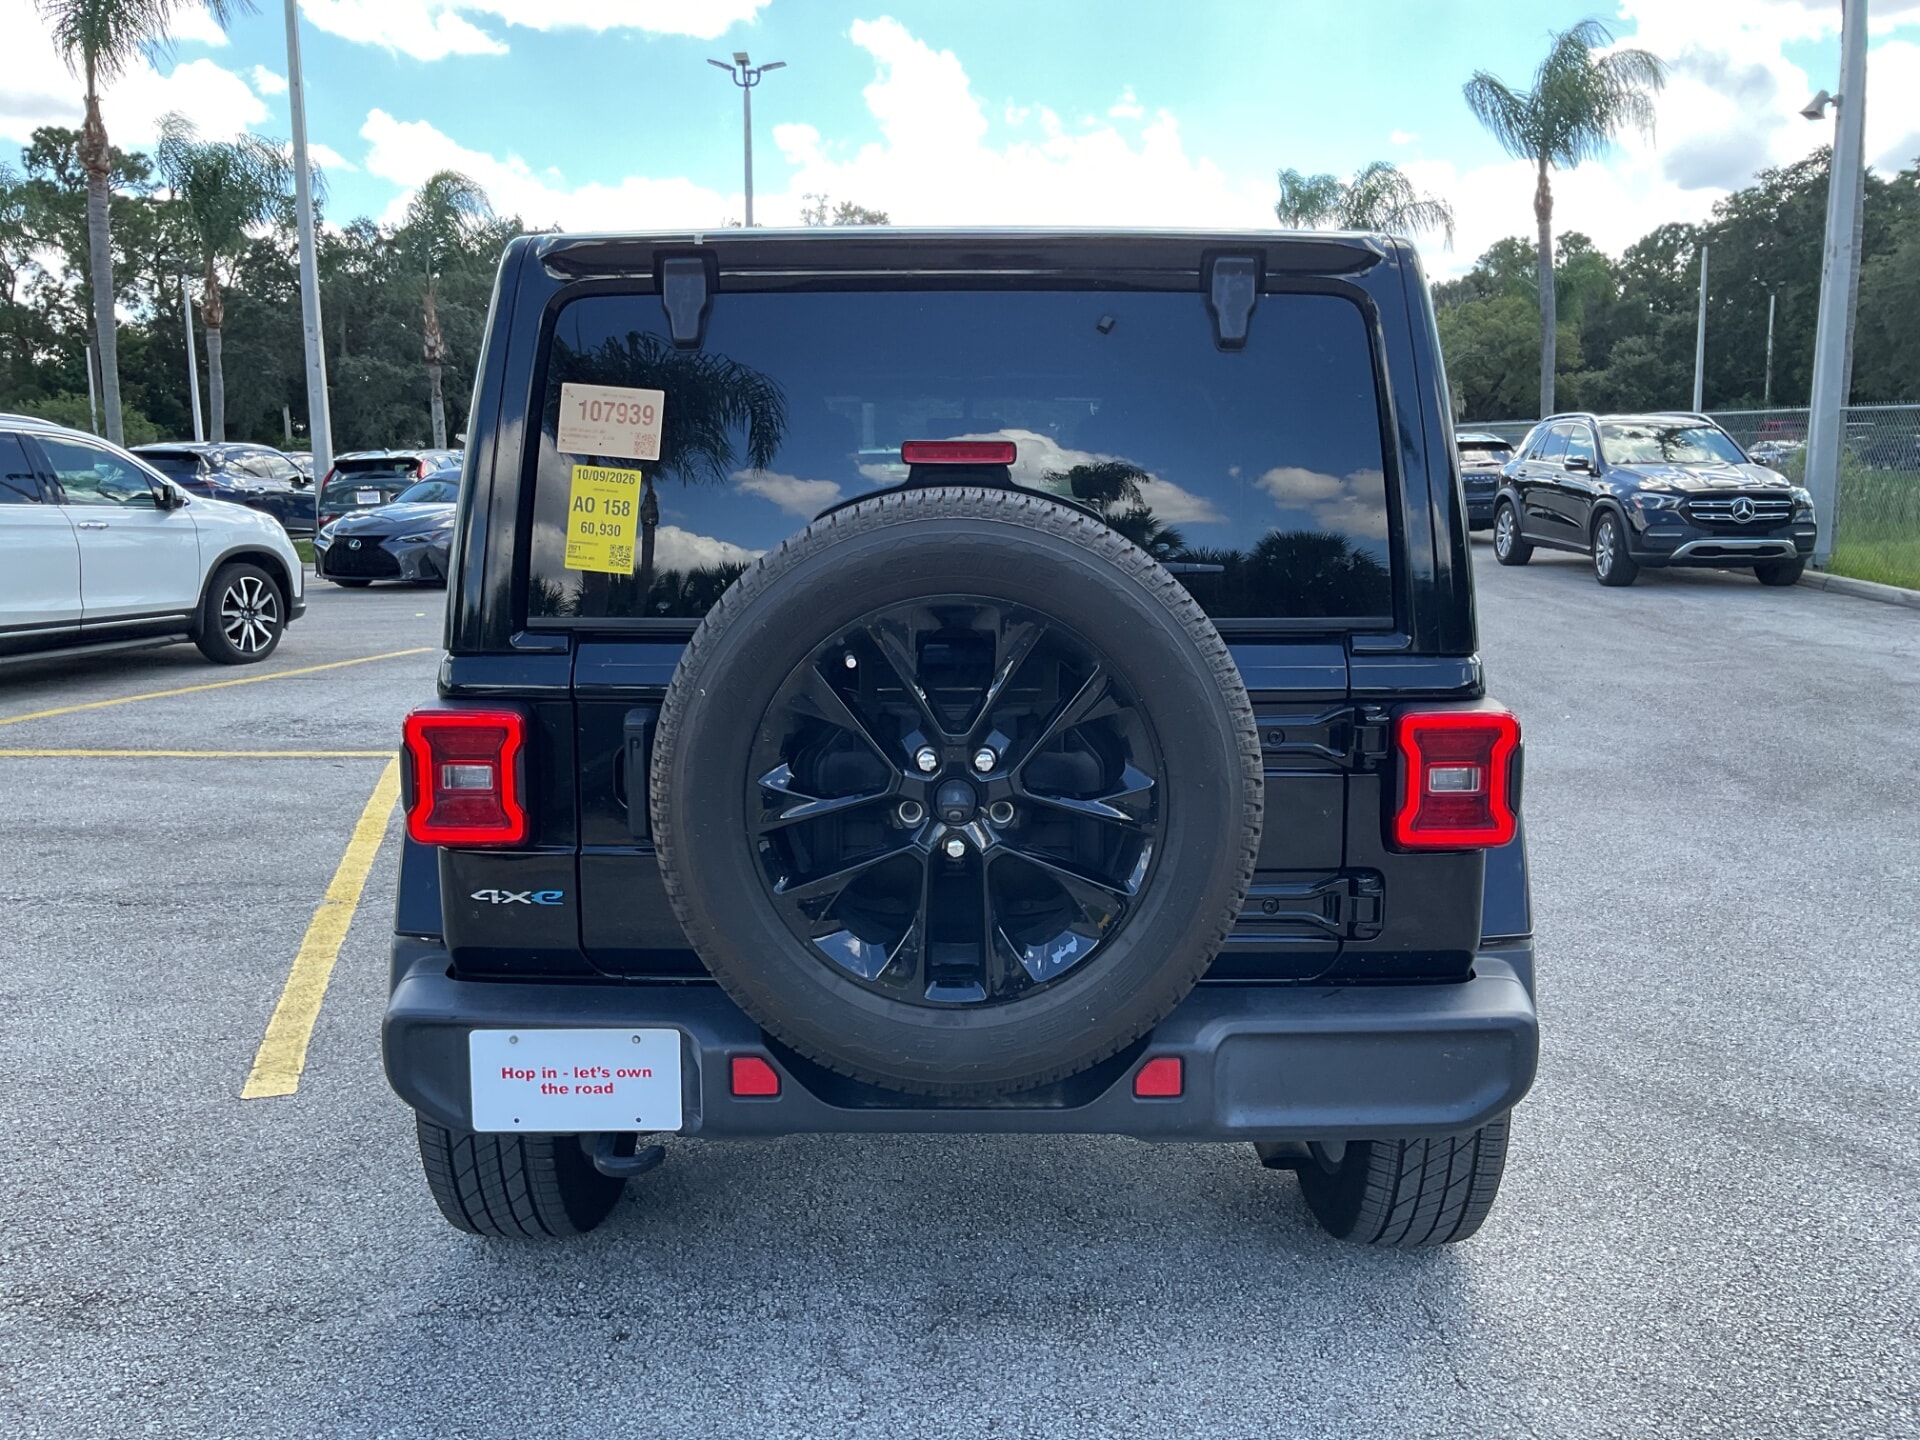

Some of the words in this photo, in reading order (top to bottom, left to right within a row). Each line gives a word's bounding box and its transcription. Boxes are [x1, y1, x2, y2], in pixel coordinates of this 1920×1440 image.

[579, 400, 655, 426] 107939
[577, 469, 636, 485] 10/09/2026
[573, 496, 596, 513] AO
[603, 499, 631, 517] 158
[580, 521, 621, 537] 60,930
[501, 1067, 535, 1081] Hop
[542, 1066, 557, 1078] in
[616, 1067, 652, 1078] own
[541, 1083, 569, 1094] the
[575, 1082, 614, 1094] road
